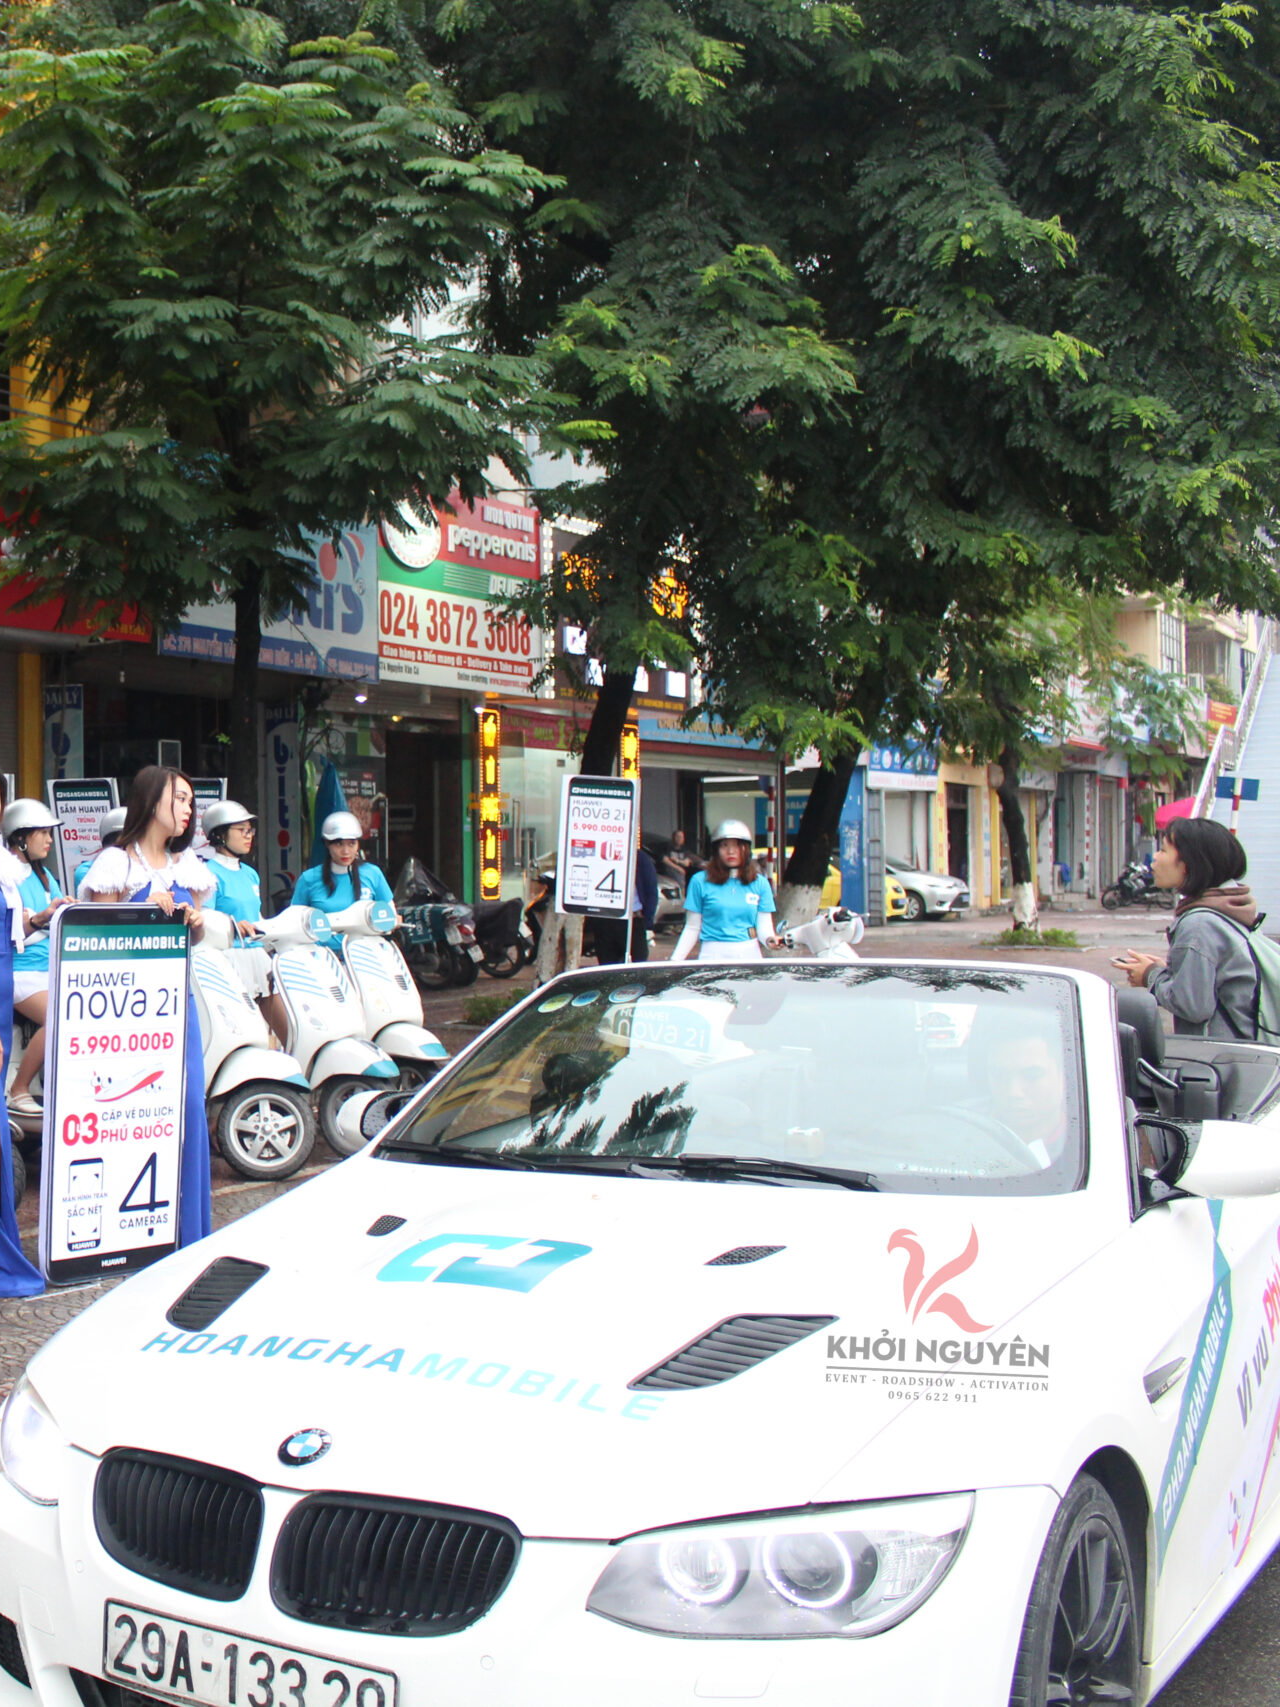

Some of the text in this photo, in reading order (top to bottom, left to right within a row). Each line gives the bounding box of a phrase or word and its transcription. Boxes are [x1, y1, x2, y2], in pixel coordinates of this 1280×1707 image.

[380, 589, 419, 639] 024
[426, 598, 478, 648] 3872
[572, 806, 626, 821] nova 2i
[64, 829, 77, 840] 03
[595, 868, 622, 894] 4
[81, 935, 186, 950] HOANGHAMOBILE
[68, 972, 135, 988] HUAWEI
[66, 987, 178, 1020] nova 2i
[69, 1032, 174, 1055] 5.990.000Đ
[620, 1017, 705, 1048] nova 2i
[62, 1112, 99, 1146] 03
[139, 1107, 151, 1118] DU
[100, 1118, 174, 1143] PHÚ QUỐC
[119, 1152, 170, 1213] 4
[119, 1213, 169, 1230] CAMERAS
[101, 1256, 127, 1267] HUAWEI
[140, 1331, 666, 1422] HOANGHAMOBILE
